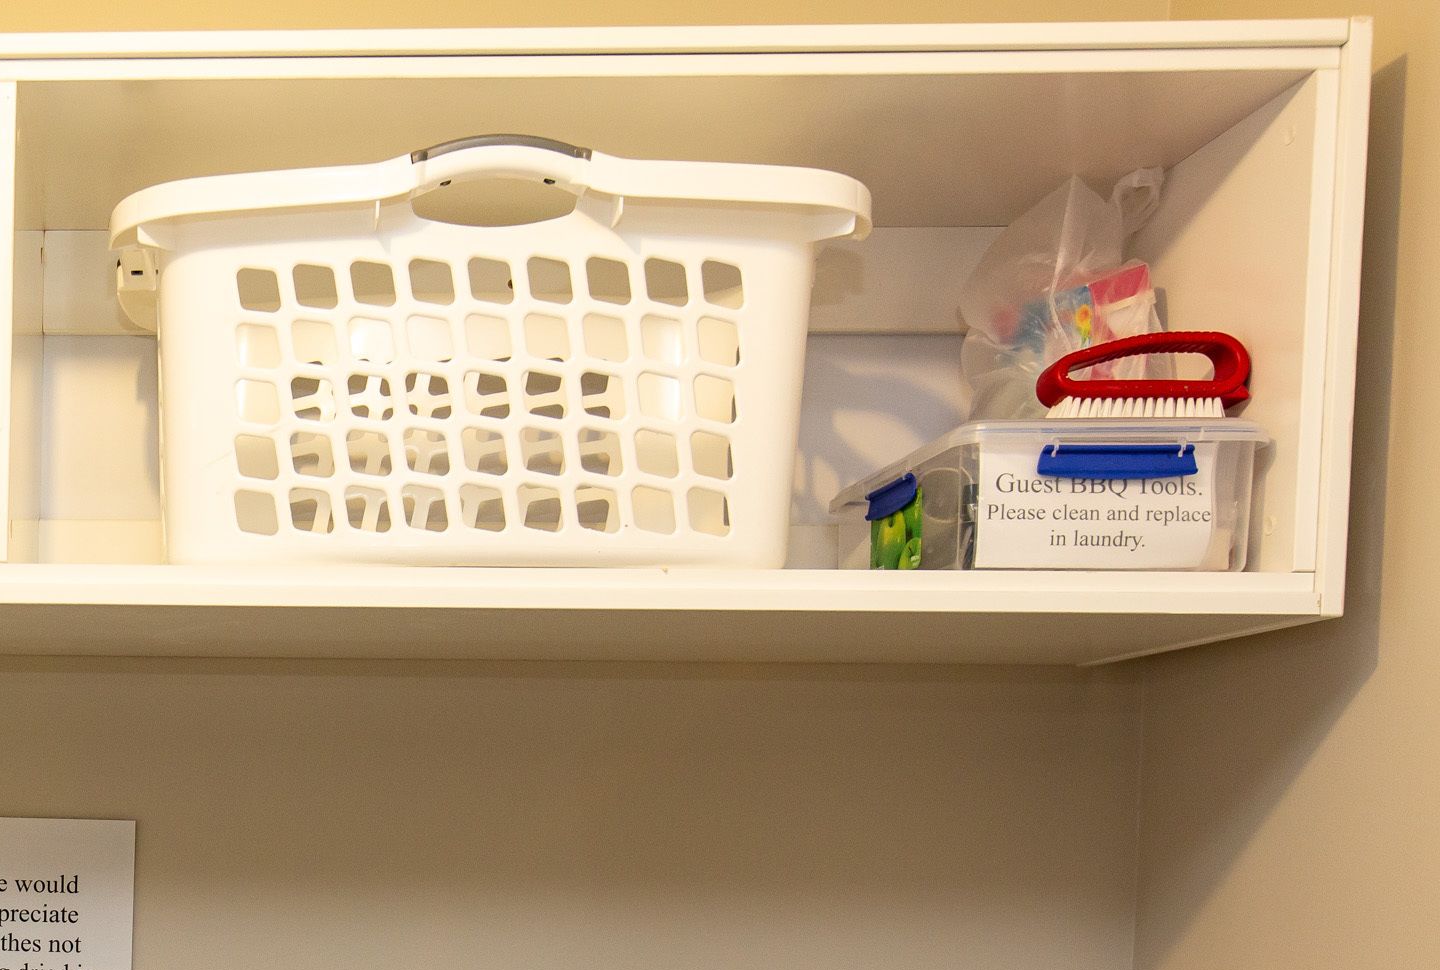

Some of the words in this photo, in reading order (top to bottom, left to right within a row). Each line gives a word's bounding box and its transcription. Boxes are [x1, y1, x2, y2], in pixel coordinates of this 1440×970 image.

[996, 473, 1061, 494] Guest
[1071, 478, 1128, 499] BBQ
[1140, 475, 1203, 496] Tools.
[987, 504, 1046, 520] Please
[1053, 504, 1099, 521] clean
[1106, 505, 1139, 521] and
[1146, 506, 1211, 526] replace
[1050, 530, 1066, 546] in
[1074, 530, 1145, 552] laundry.
[15, 875, 78, 894] would
[48, 938, 81, 954] not
